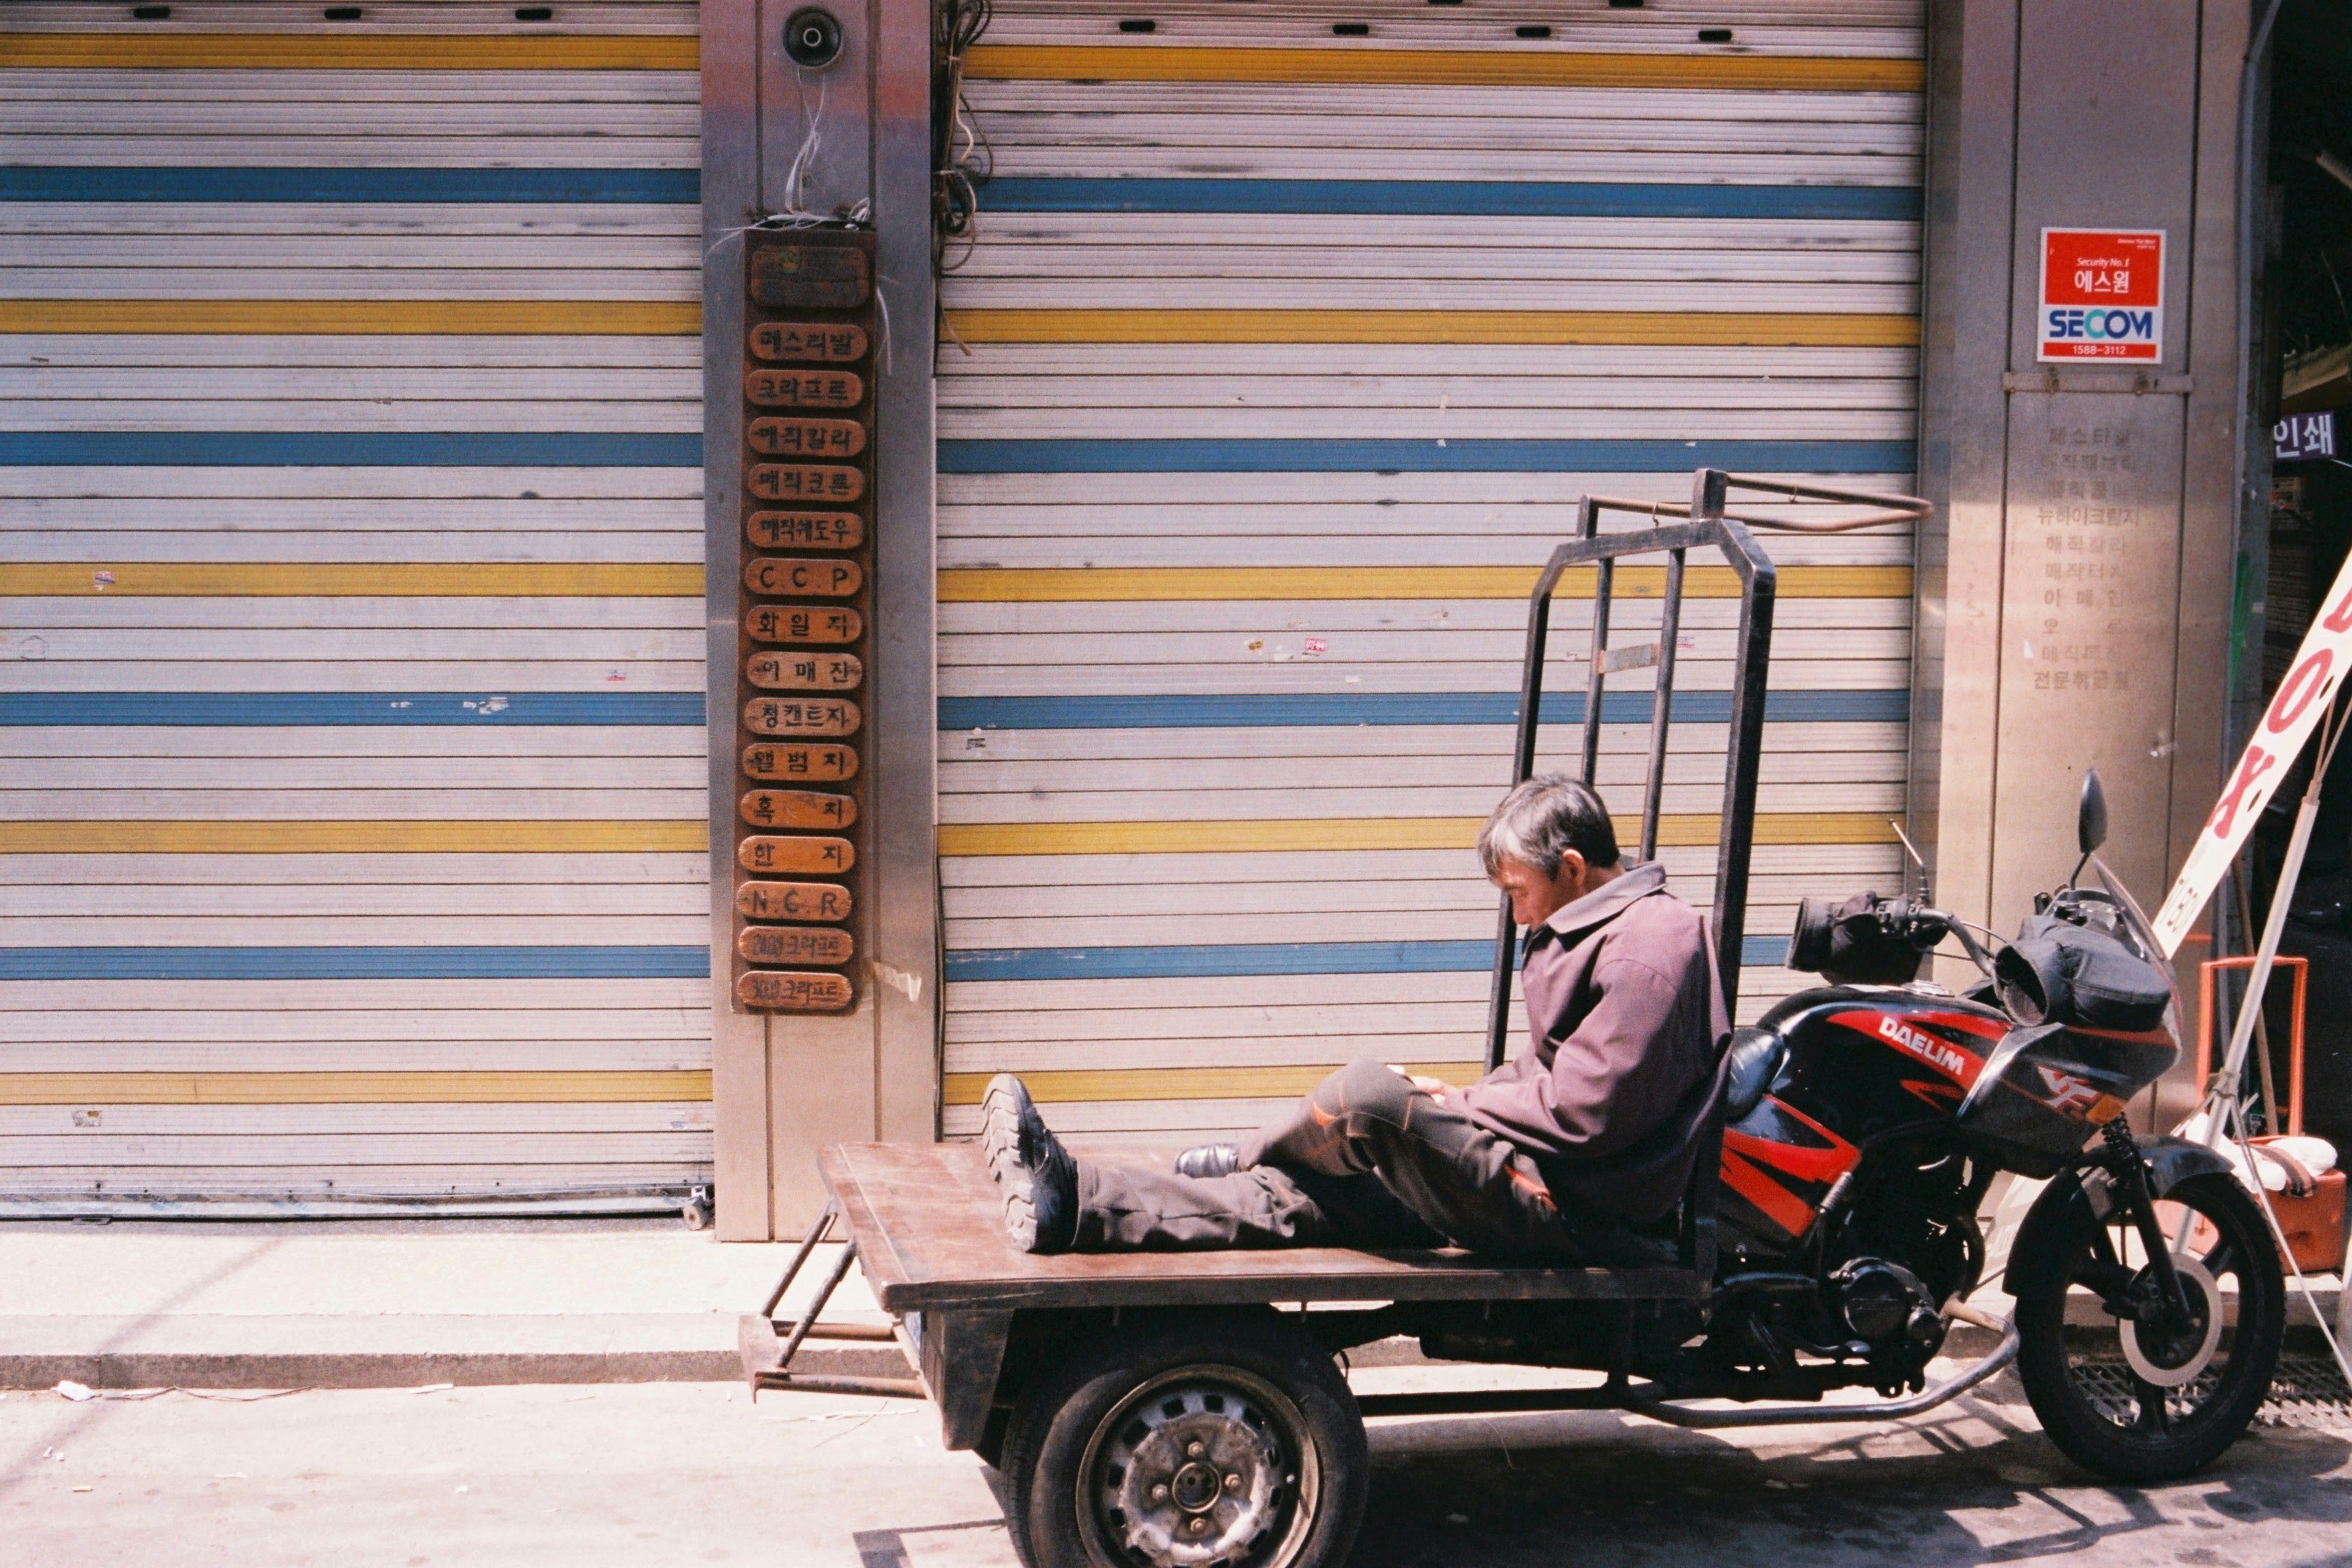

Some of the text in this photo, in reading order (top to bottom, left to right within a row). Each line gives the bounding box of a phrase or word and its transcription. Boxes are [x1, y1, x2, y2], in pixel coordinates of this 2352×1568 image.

[2077, 257, 2109, 268] Security
[2074, 270, 2129, 293] 에스원
[2049, 309, 2152, 340] SECOM
[2073, 345, 2126, 356] 1588-3112
[757, 377, 849, 402] 크라프트
[2274, 414, 2334, 458] 인쇄
[1879, 1016, 1965, 1076] DAELIM
